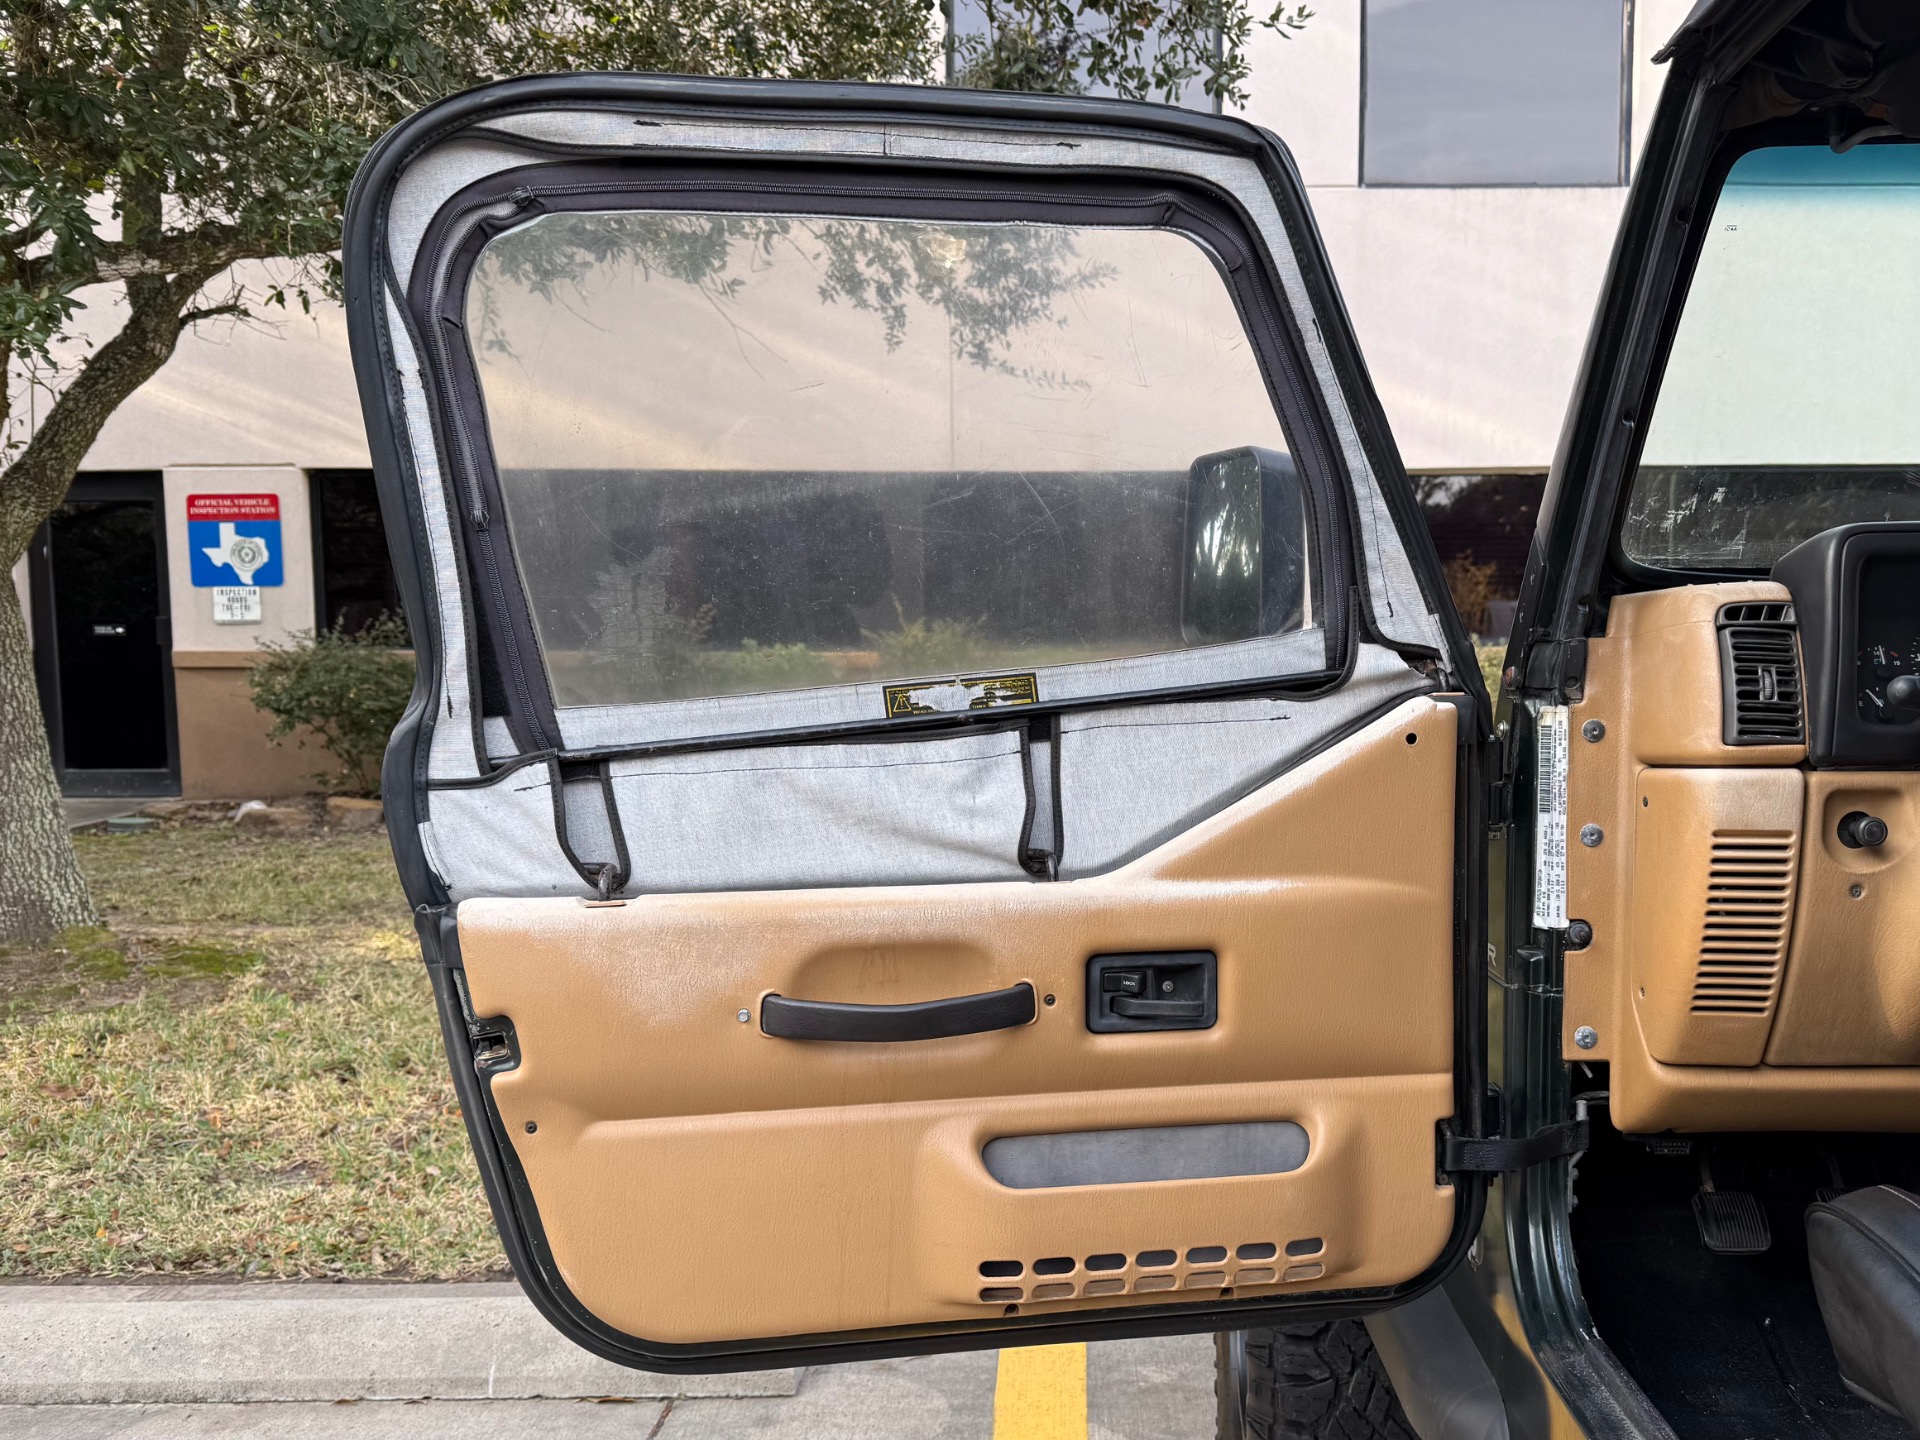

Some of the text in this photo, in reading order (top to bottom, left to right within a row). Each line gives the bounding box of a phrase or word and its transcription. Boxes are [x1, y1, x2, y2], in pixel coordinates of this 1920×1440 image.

[195, 498, 271, 506] OFFICIAL VEHICLE
[190, 506, 276, 515] INSPECTION STATION
